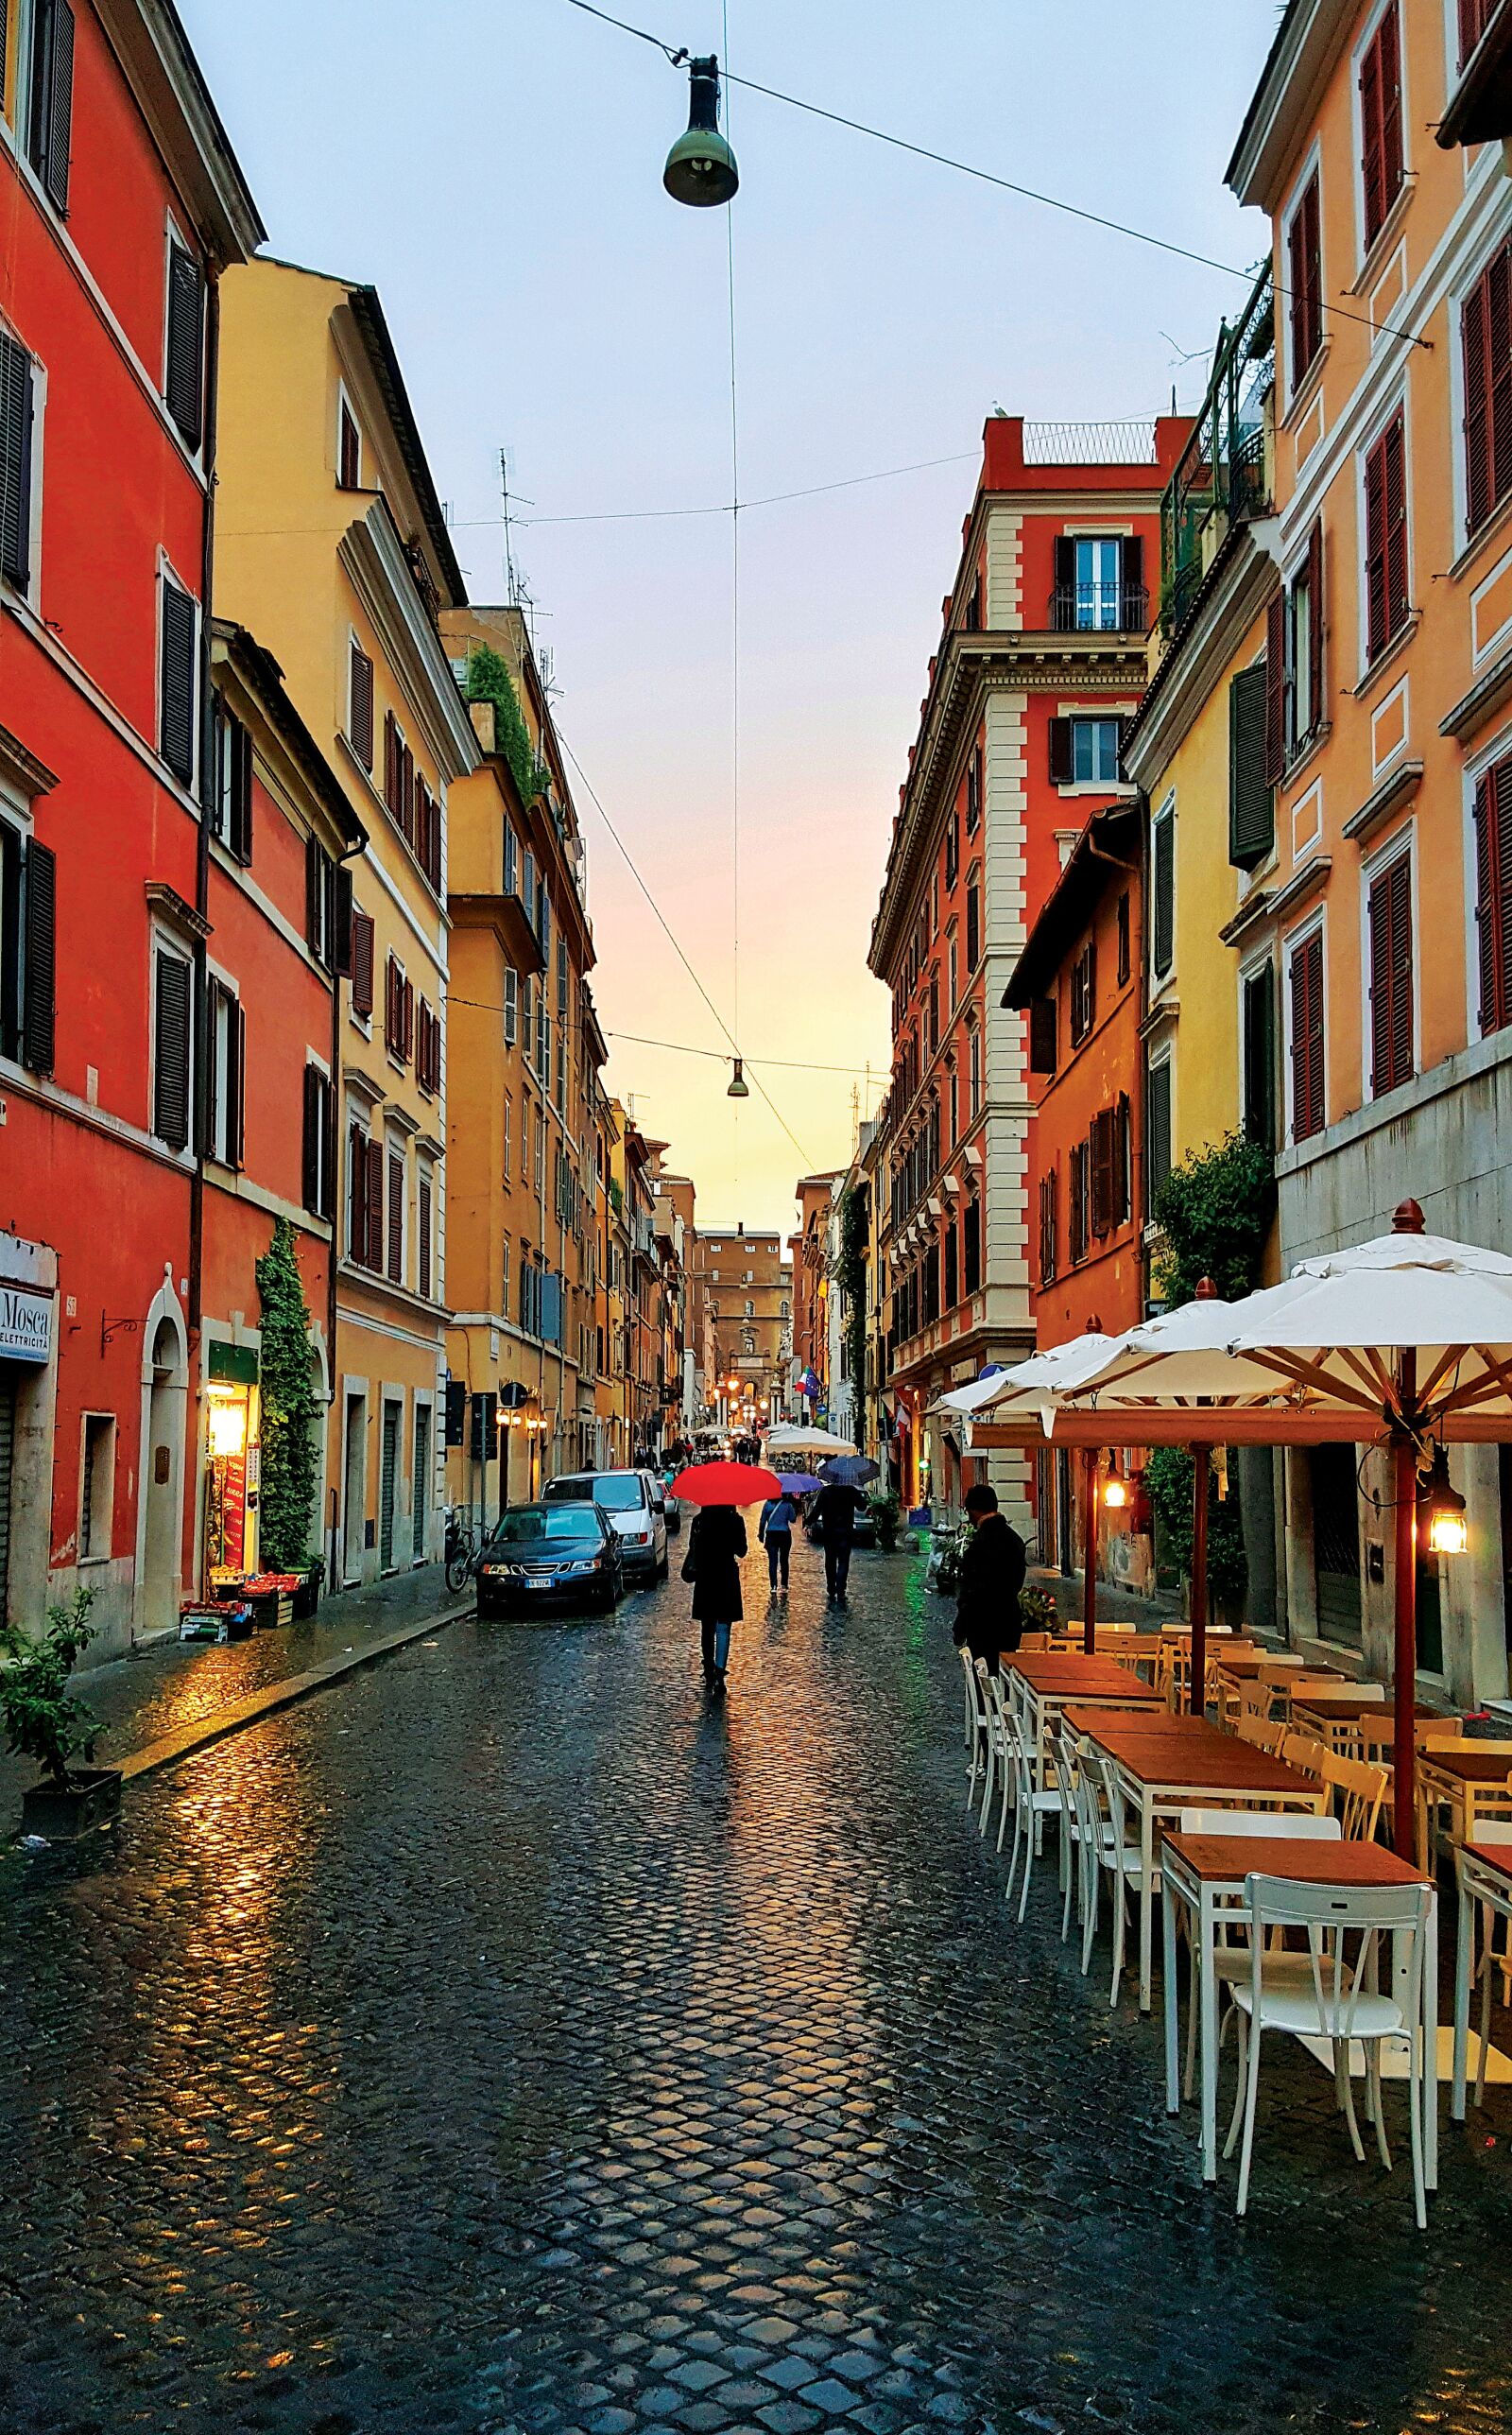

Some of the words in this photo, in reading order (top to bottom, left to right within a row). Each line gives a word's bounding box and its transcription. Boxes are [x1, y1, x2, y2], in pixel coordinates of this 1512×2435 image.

[1, 1292, 48, 1336] Mosca
[0, 1332, 47, 1349] ELETTRICITÀ
[227, 1487, 243, 1498] BIRRA
